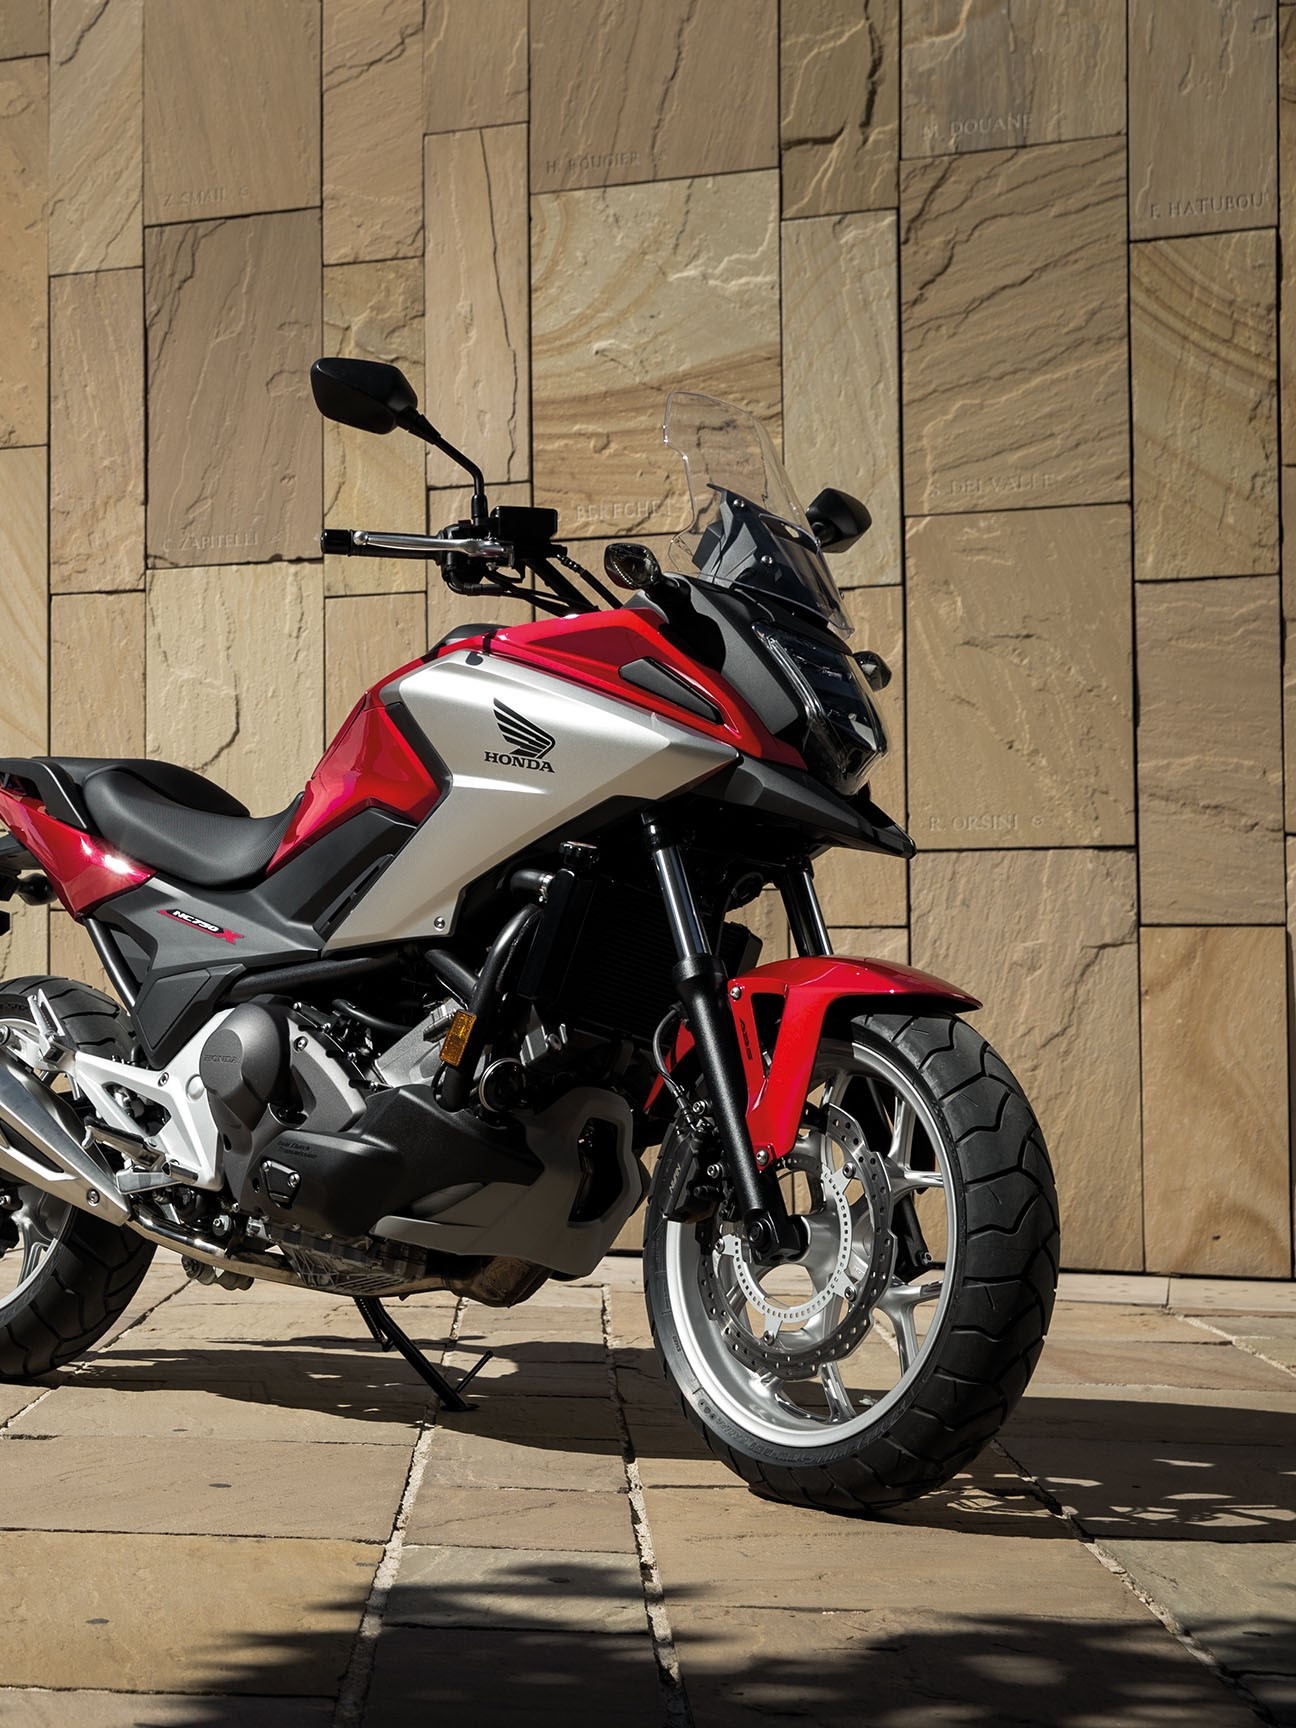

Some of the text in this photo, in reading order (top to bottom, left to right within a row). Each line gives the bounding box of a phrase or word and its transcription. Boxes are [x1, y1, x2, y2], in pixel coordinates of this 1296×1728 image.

[949, 112, 1033, 137] DOUANE
[179, 530, 259, 552] ZAPITELLI
[484, 750, 556, 774] HONDA
[952, 812, 1020, 833] ORSINI
[204, 1055, 239, 1064] HONDA
